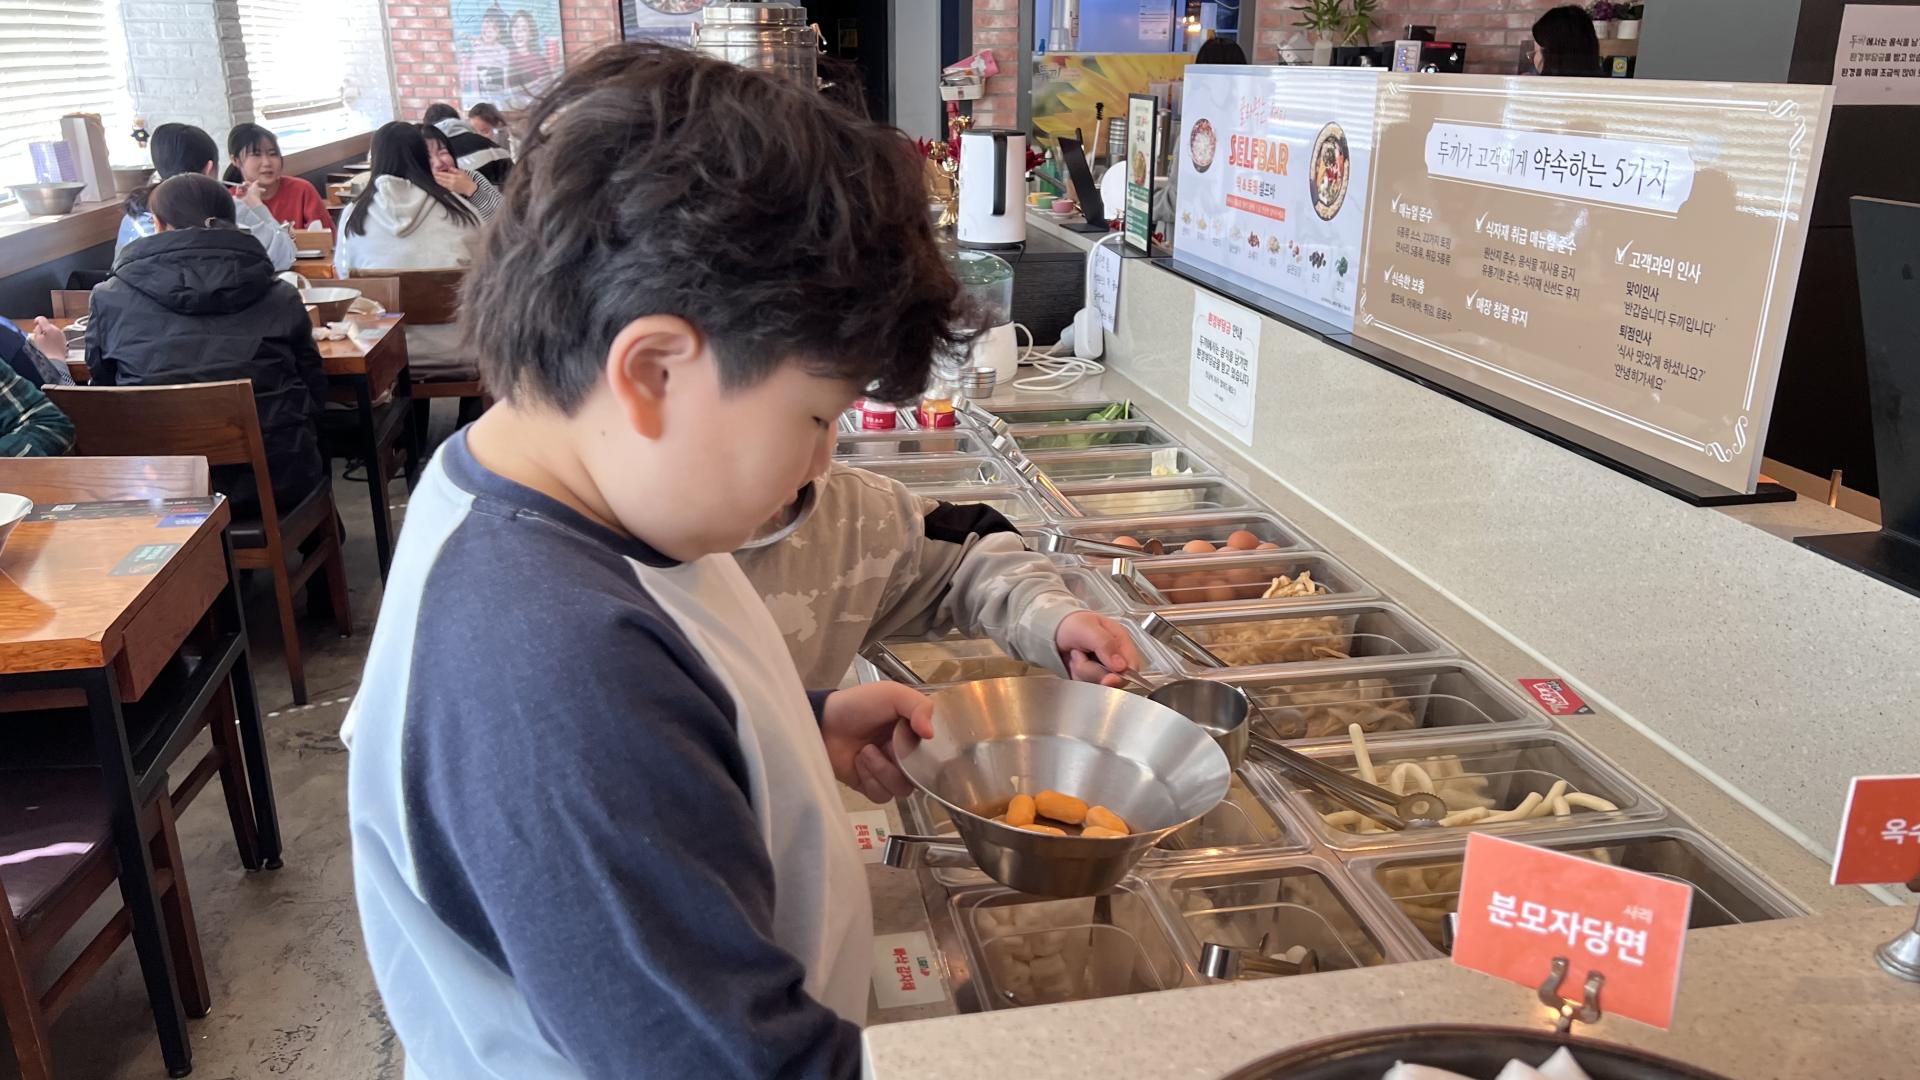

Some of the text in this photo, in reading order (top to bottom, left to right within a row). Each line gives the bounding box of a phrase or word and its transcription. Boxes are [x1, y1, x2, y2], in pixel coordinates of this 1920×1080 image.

[1889, 37, 1910, 47] 음식을
[1850, 52, 1892, 62] 환경부담금을
[1893, 52, 1907, 62] 받고
[1841, 68, 1863, 77] 환경을
[1864, 68, 1879, 78] 위해
[1880, 68, 1901, 78] 조금씩
[1228, 134, 1290, 176] SELFBAR
[1437, 139, 1670, 199] 두끼가 고객에게 약속하는 5가지
[1399, 203, 1433, 223] 메뉴얼 준수
[1486, 221, 1577, 256] 식자재 취급 메뉴얼 준수
[1483, 247, 1576, 281] 원산지 준수, 음식물 재사용 금지
[1628, 252, 1702, 285] 고객과의 인사
[1391, 271, 1425, 295] 신속한 보충
[1482, 264, 1580, 302] 유통기한 준수, 식자재 신선도 유지
[1626, 281, 1660, 302] 맞이인사
[1475, 297, 1529, 328] 매장 청결 유지
[1618, 324, 1652, 346] 퇴점인사
[1635, 349, 1662, 370] 맛있게
[1623, 904, 1654, 925] 사리
[1487, 890, 1648, 967] 분모자당면
